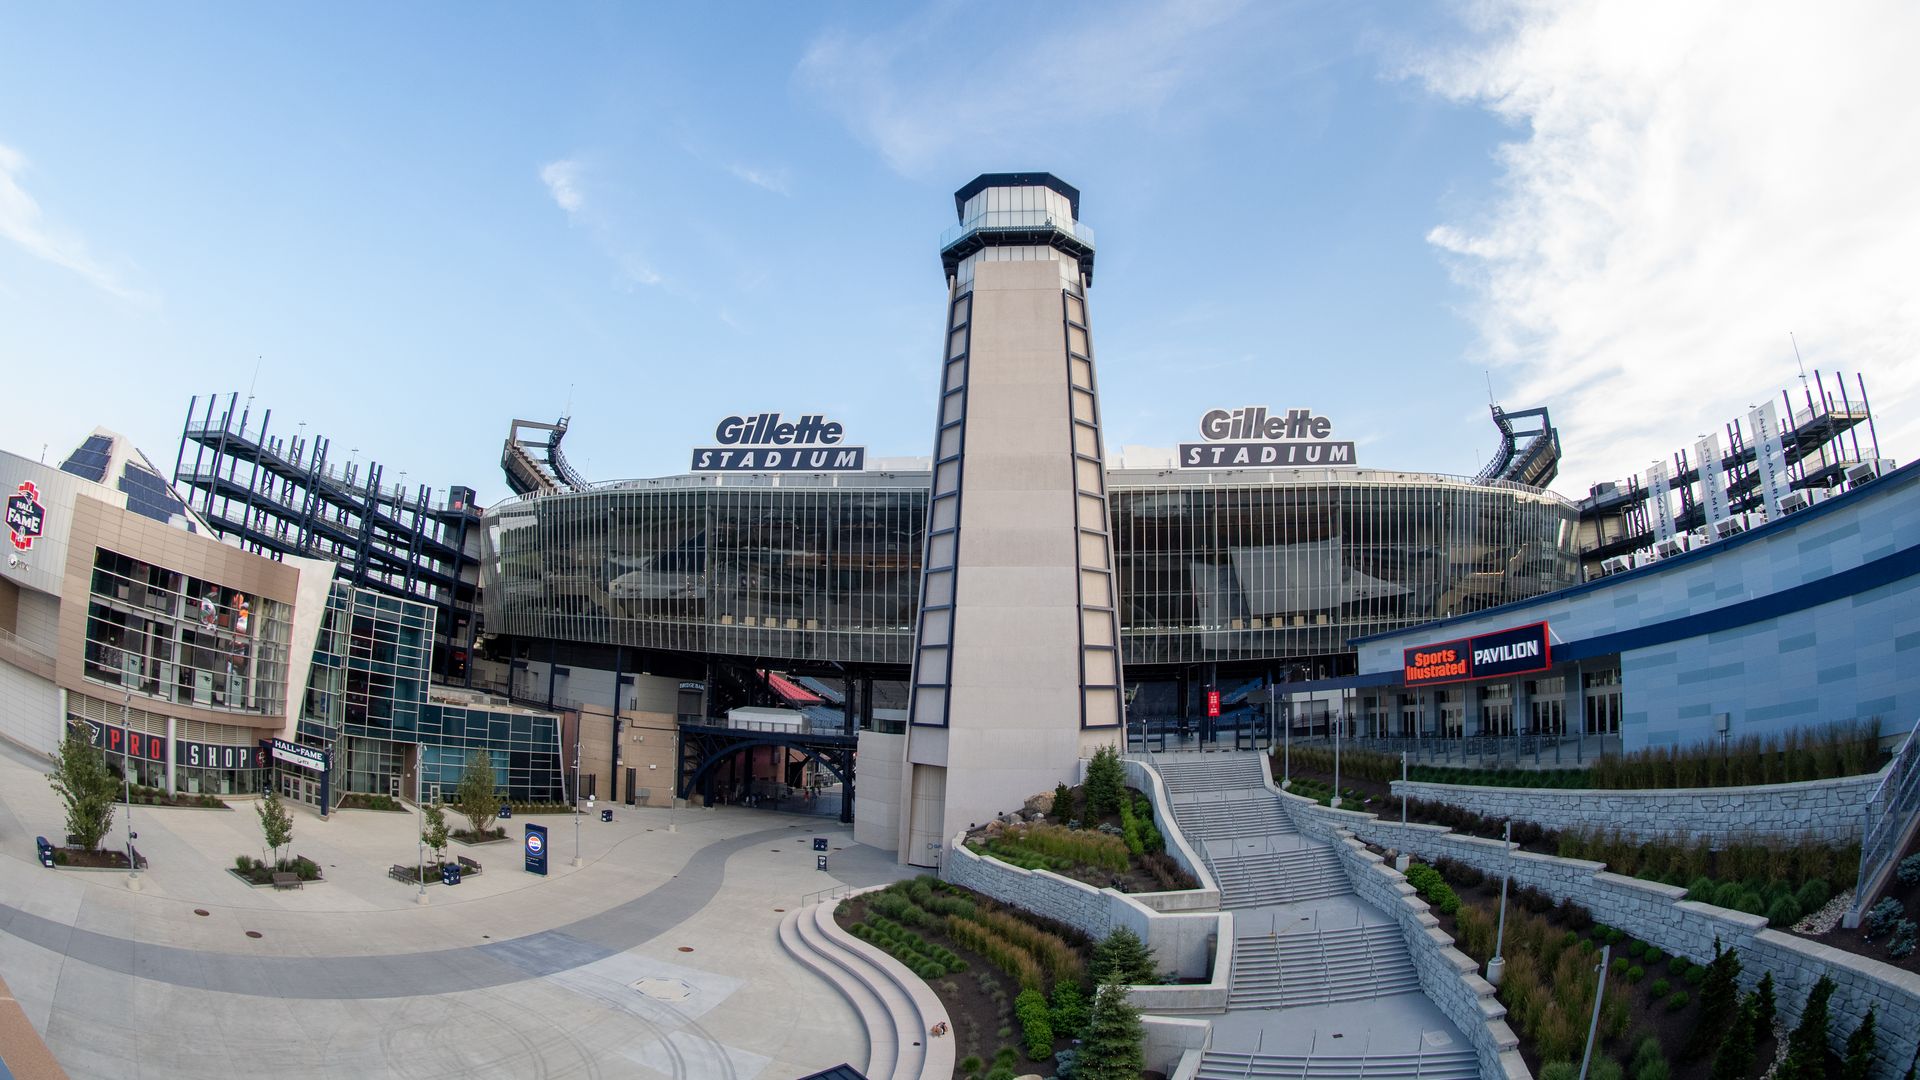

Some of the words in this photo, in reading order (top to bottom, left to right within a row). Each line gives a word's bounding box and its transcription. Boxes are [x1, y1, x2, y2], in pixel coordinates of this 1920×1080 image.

[715, 413, 843, 446] Gillette
[1201, 407, 1332, 440] Gillette
[698, 450, 857, 468] STADIUM
[1187, 445, 1349, 465] STADIUM
[16, 501, 34, 513] HALL
[7, 507, 40, 533] FAME
[1414, 649, 1456, 667] Sports
[1474, 640, 1539, 665] PAVILION
[1406, 659, 1468, 680] Illustrated
[110, 729, 160, 760] PRO
[190, 745, 247, 768] SHOP
[275, 740, 296, 753] HALL
[300, 748, 322, 760] FAME
